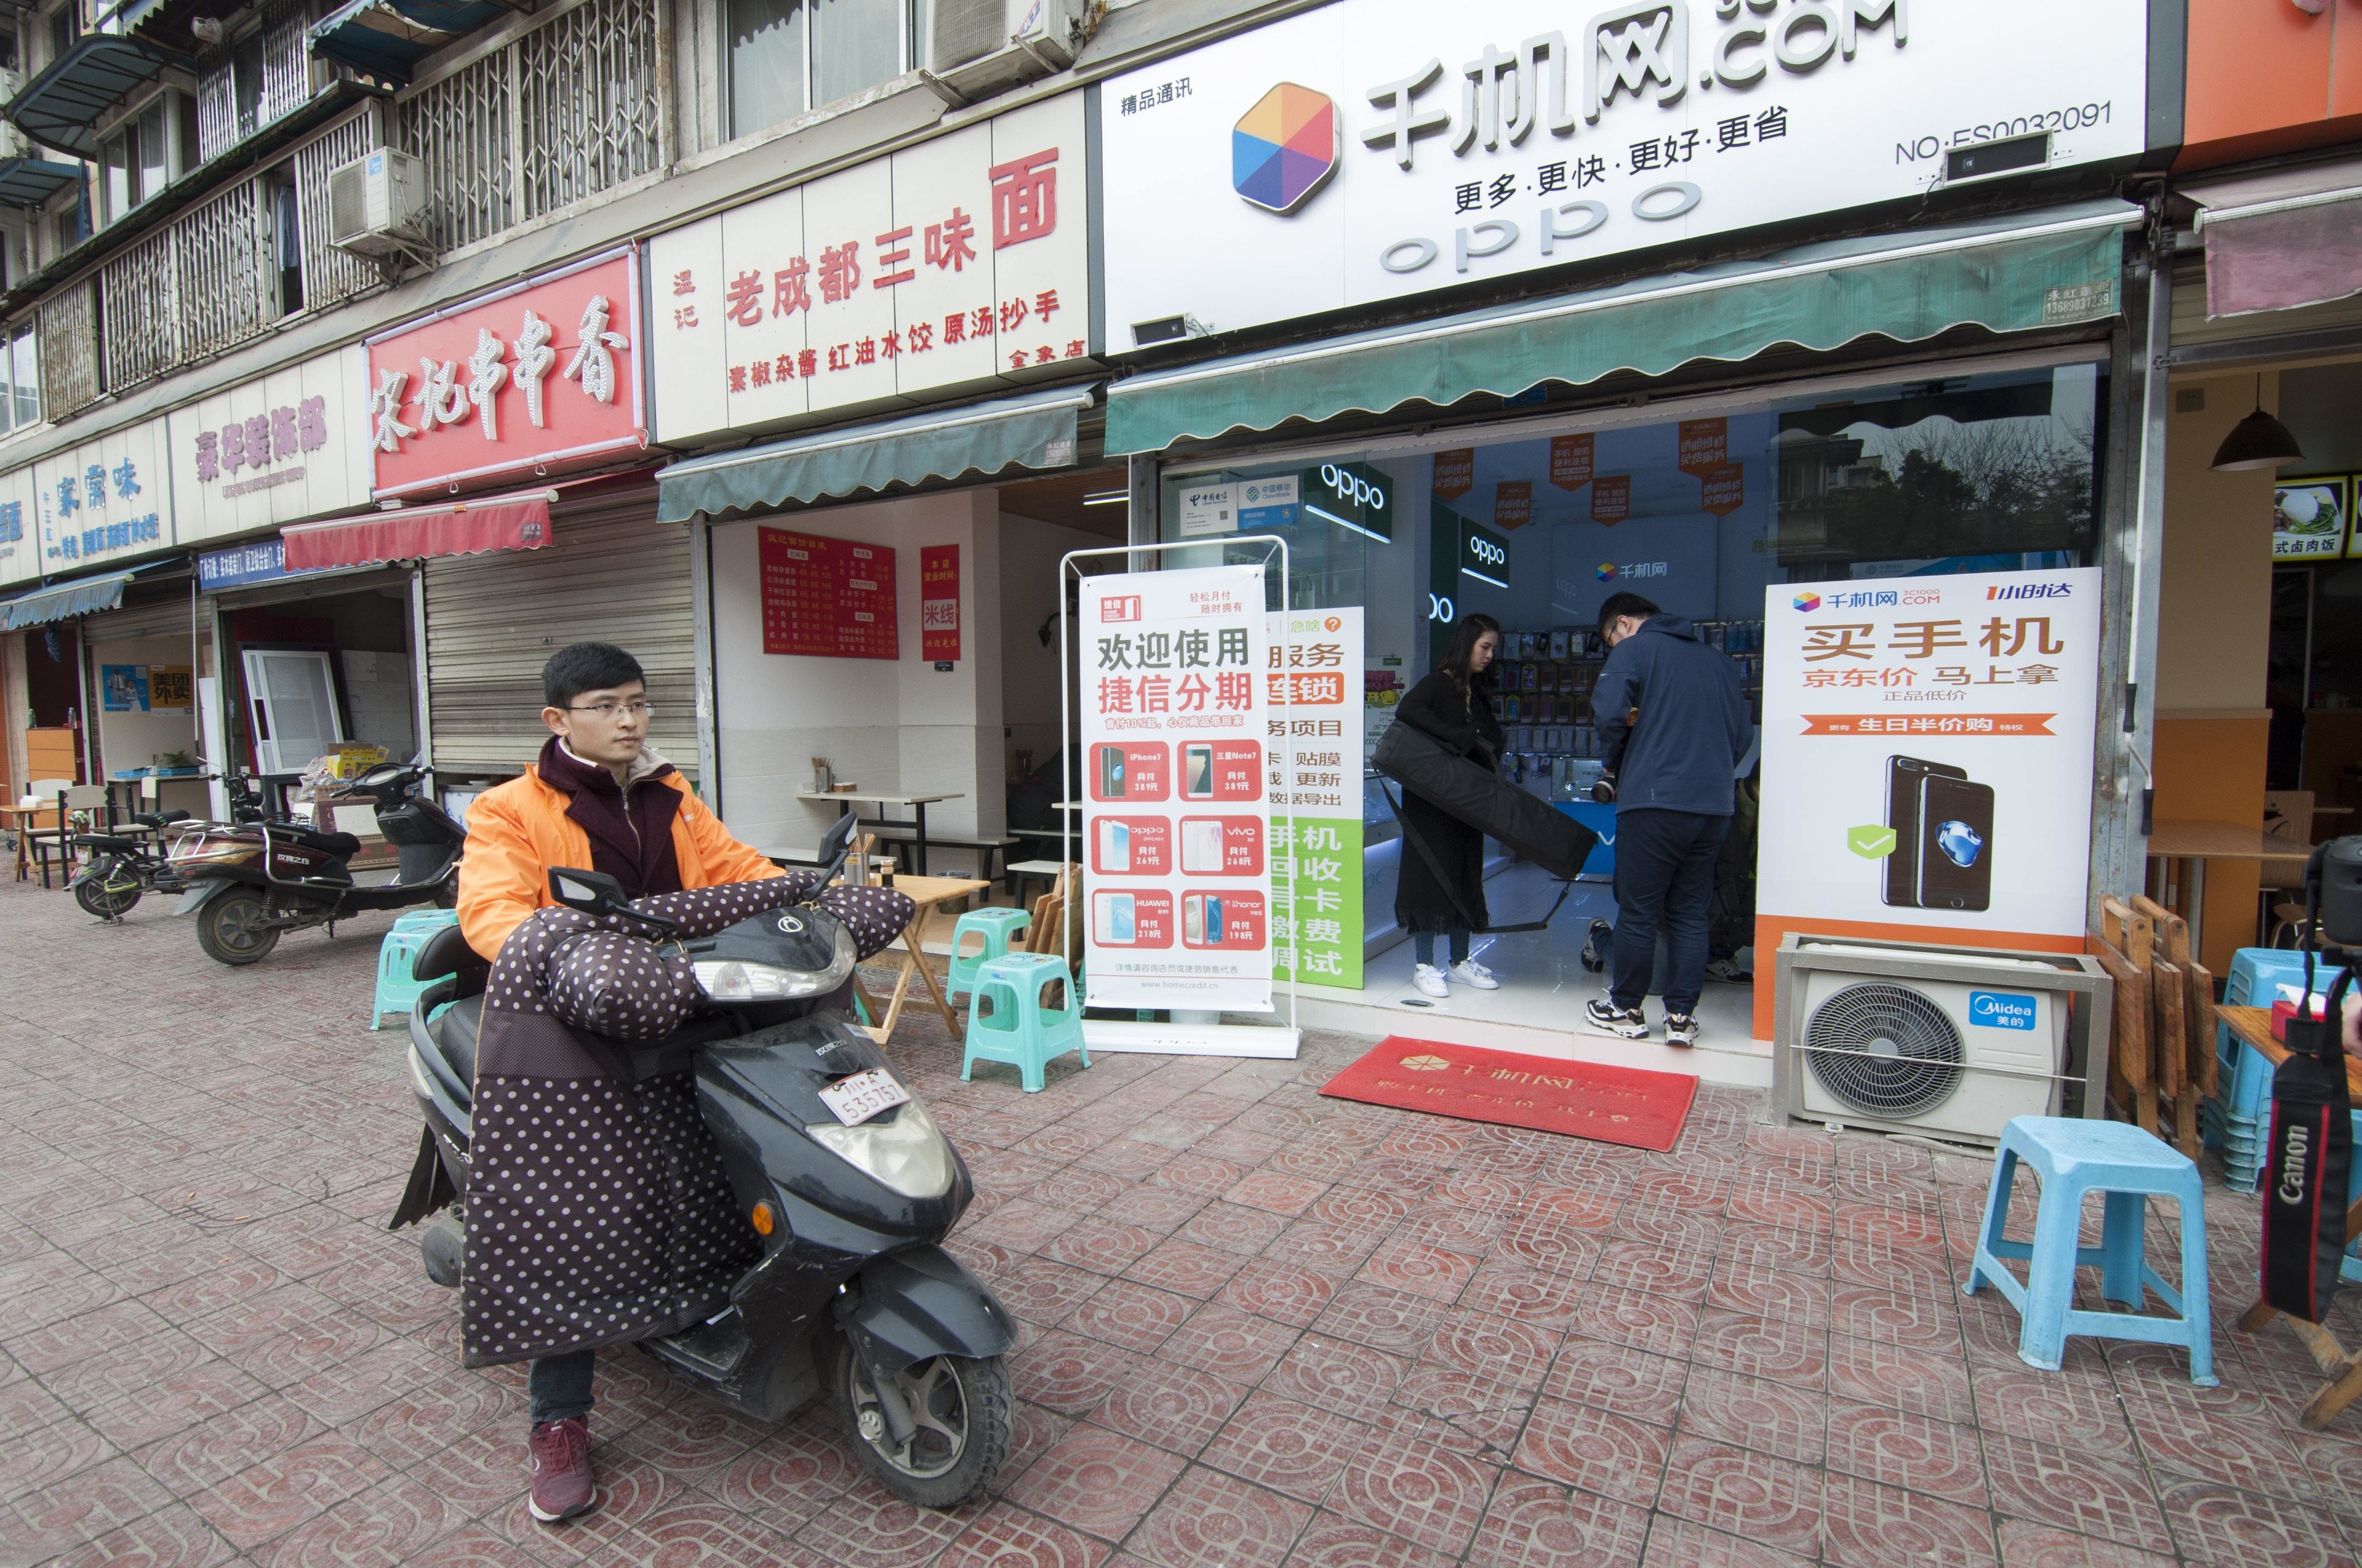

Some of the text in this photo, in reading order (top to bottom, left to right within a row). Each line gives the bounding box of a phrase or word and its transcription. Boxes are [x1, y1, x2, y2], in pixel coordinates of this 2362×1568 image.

[1120, 77, 1193, 117] 精品通讯
[726, 146, 1059, 327] 老成都三味面
[673, 268, 699, 330] 温记
[2047, 293, 2109, 314] 13689031239
[828, 321, 935, 373] 红油水饺
[943, 288, 1060, 345] 原汤抄手
[1007, 338, 1087, 369] 金象店
[195, 394, 327, 483] 豪华装饰部
[1554, 456, 1590, 467] 便利连锁
[1680, 449, 1725, 466] 免费服务
[57, 456, 141, 518] 家常味
[1262, 483, 1291, 494] 中国移动
[767, 533, 827, 550] 温记面价目表
[2275, 538, 2336, 554] 式卤肉饭
[931, 559, 951, 569] 本店
[1619, 561, 1667, 579] 千机网
[1190, 590, 1231, 604] 轻松月付
[1903, 588, 1940, 597] 3C1000
[1987, 583, 2073, 601] 1小时达
[1103, 599, 1121, 609] 捷信
[1827, 590, 1898, 609] 千机网
[924, 604, 954, 625] 米线
[1201, 602, 1243, 615] 随时拥有
[1290, 619, 1321, 633] 急啥
[926, 639, 957, 648] 欢迎光临
[1801, 616, 2064, 662] 买手机
[1097, 628, 1250, 671] 欢迎使用
[1268, 642, 1344, 668] 服务
[153, 673, 190, 686] 美团
[1802, 664, 2059, 688] 京东价 马上拿
[155, 687, 191, 704] 外卖
[1098, 671, 1252, 714] 捷信分期
[1268, 676, 1338, 702] 连锁
[1882, 690, 1968, 702] 正品低价
[1166, 714, 1244, 728] 心仪商品带回家
[1828, 724, 1850, 732] 更有
[1858, 717, 1994, 733] 生日半价购
[1216, 752, 1257, 760] 三星Note7
[1295, 752, 1341, 767] 贴膜
[1137, 772, 1155, 781] 月付
[1228, 771, 1246, 780] 月付
[1296, 771, 1341, 787] 更新
[1134, 782, 1158, 791] 389元
[1225, 781, 1250, 790] 389元
[1269, 792, 1341, 806] 数据导出
[1226, 827, 1255, 835] vivo
[1271, 825, 1342, 851] 手机
[1139, 846, 1156, 855] 月付
[1230, 846, 1248, 856] 月付
[1136, 857, 1160, 865] 269元
[1227, 857, 1252, 866] 268元
[1141, 920, 1158, 928] 月付
[1231, 921, 1250, 929] 月付
[1138, 930, 1161, 938] 218元
[1230, 932, 1253, 940] 198元
[1115, 963, 1239, 974] 详情请咨询店员或捷信销售代表
[1140, 981, 1219, 990] www.homecredit.cn
[1974, 994, 2032, 1018] Midea
[1996, 1016, 2024, 1028] 美的
[842, 1085, 902, 1118] 535757
[2279, 1123, 2310, 1206] Canon
